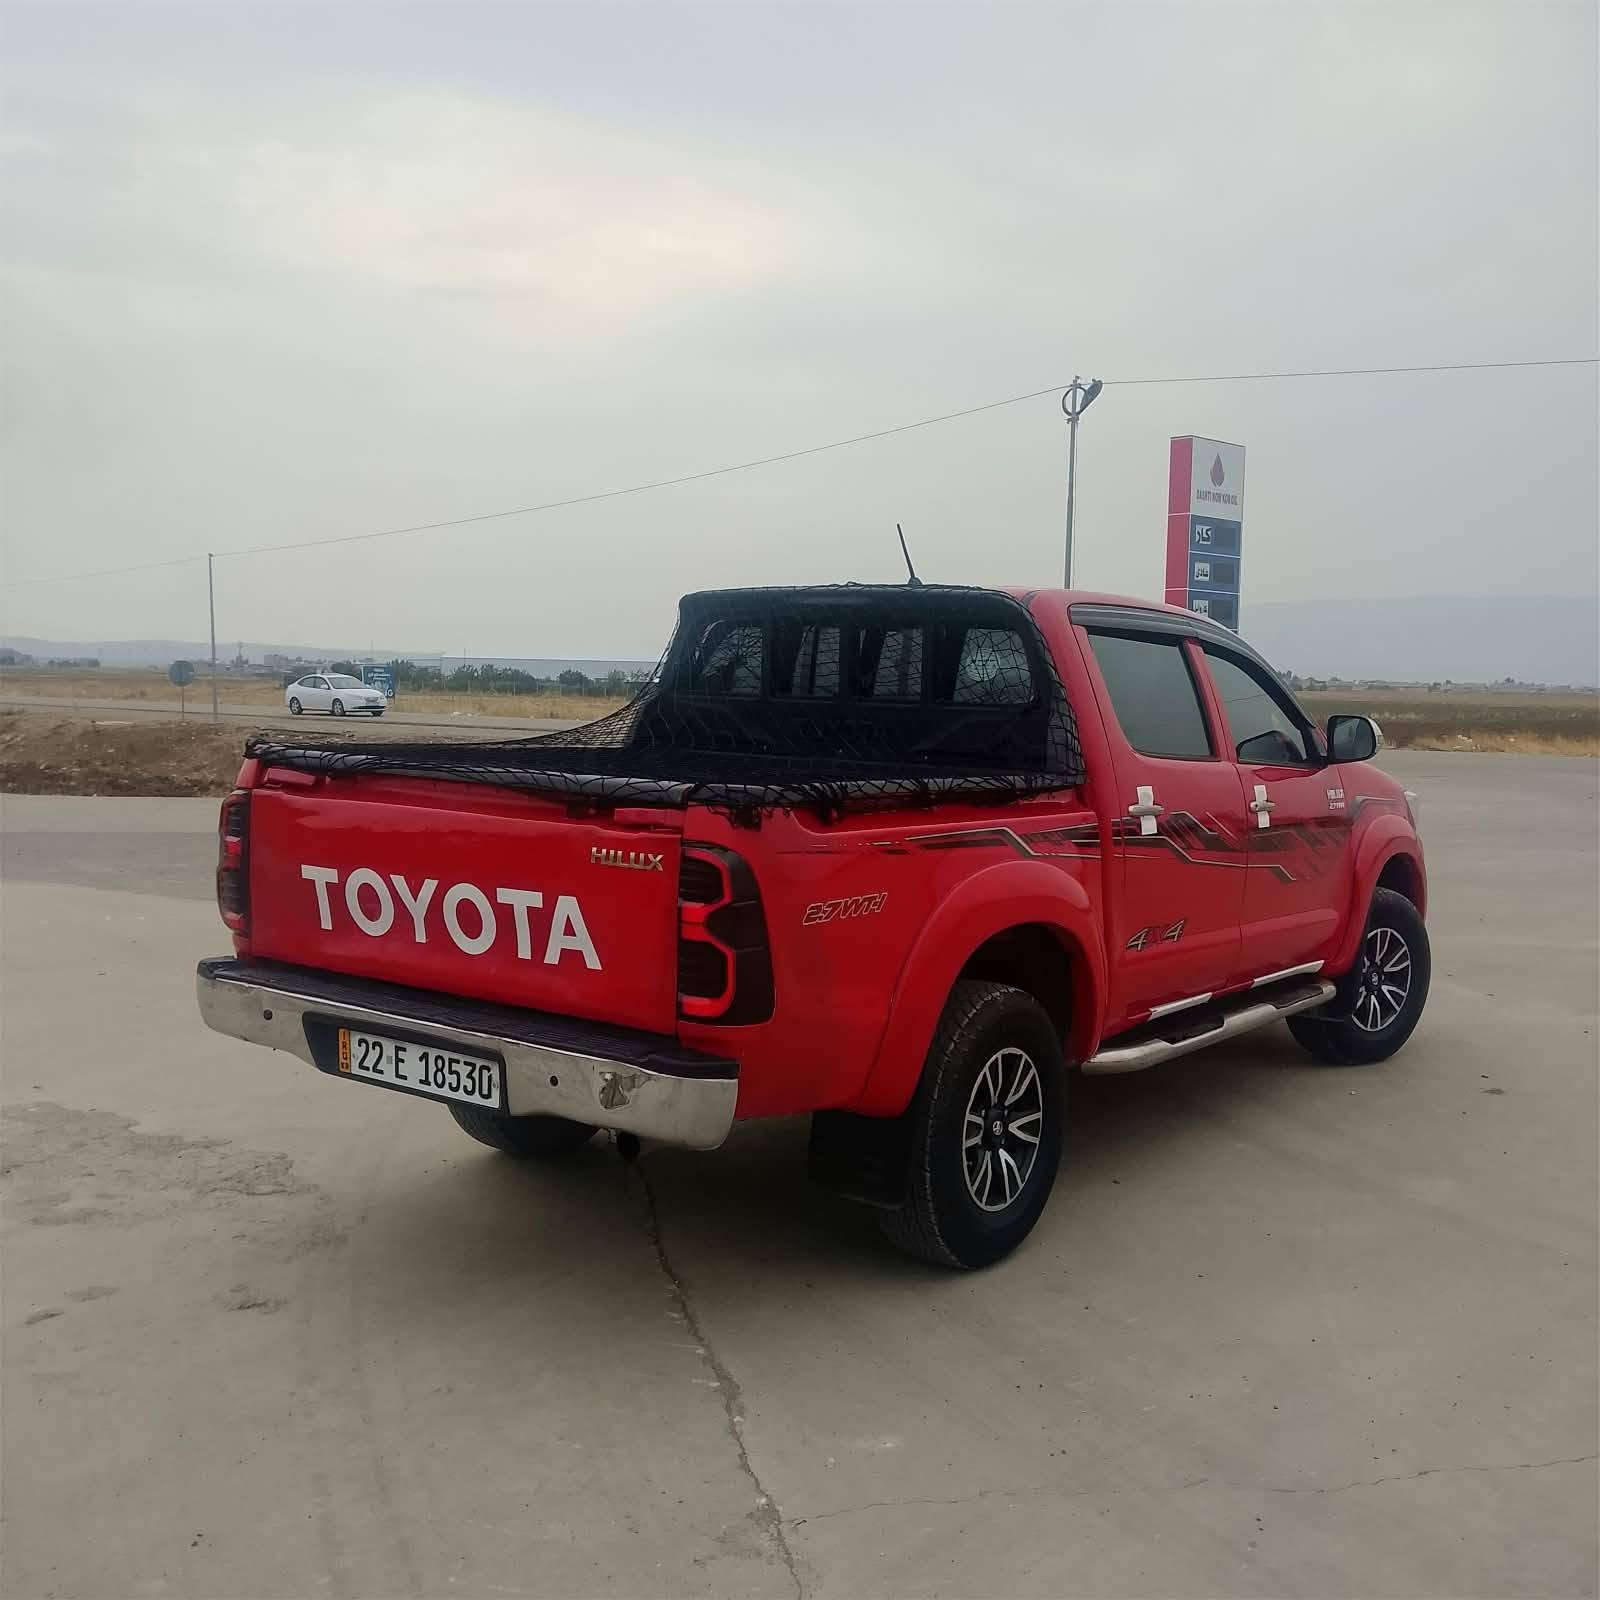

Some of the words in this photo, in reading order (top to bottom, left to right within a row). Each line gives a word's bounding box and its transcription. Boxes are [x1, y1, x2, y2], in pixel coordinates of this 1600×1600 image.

[591, 847, 664, 871] HILUX
[301, 864, 603, 971] TOYOTA
[358, 1038, 384, 1075] 22
[394, 1045, 408, 1081] E
[418, 1051, 493, 1100] 18530
